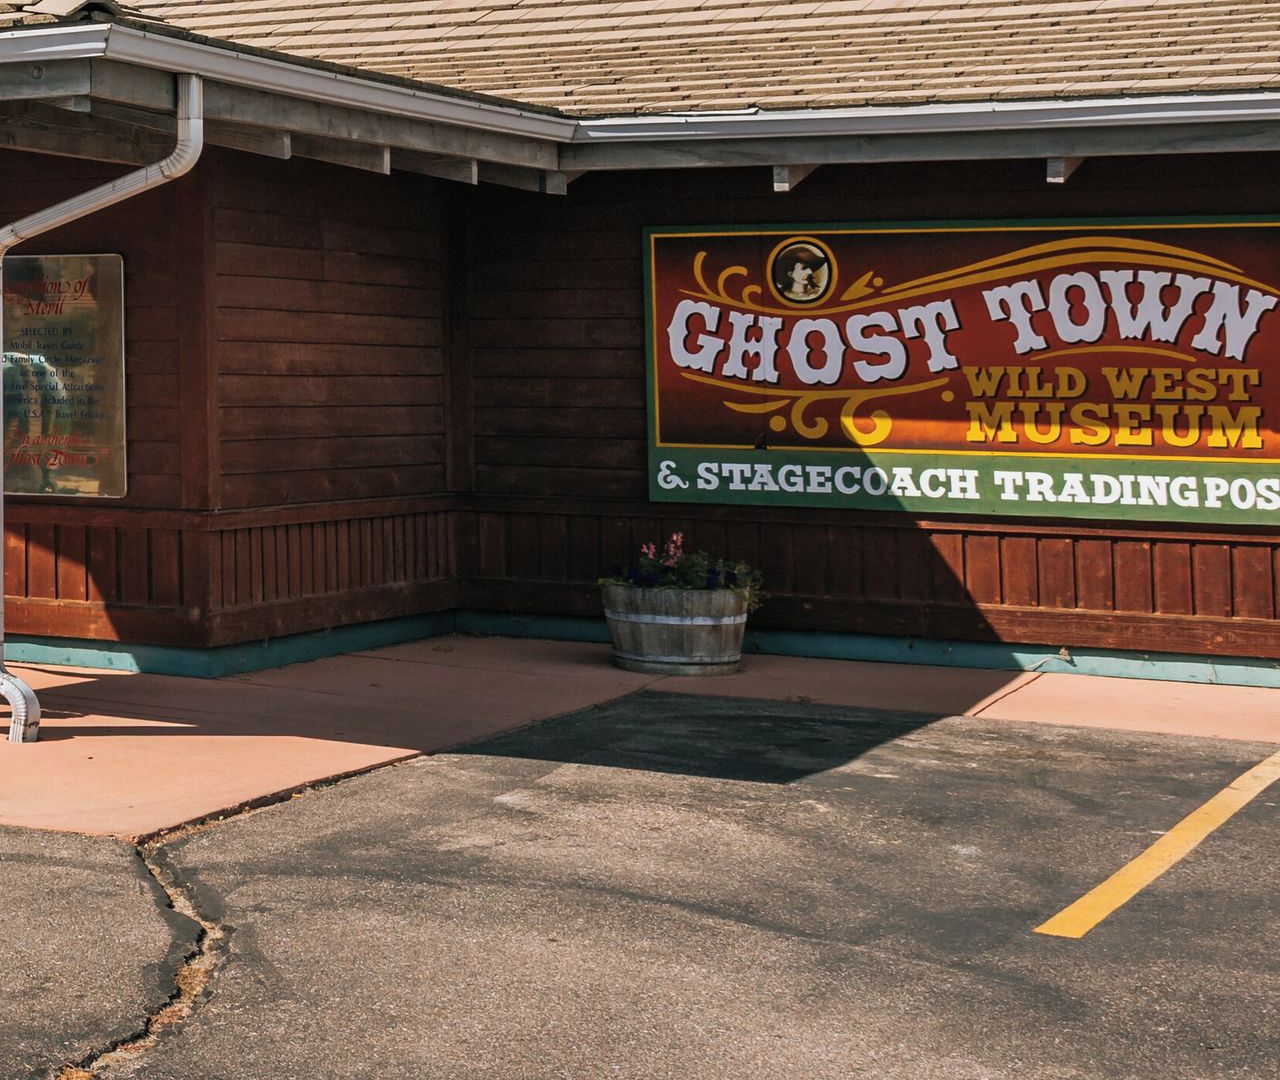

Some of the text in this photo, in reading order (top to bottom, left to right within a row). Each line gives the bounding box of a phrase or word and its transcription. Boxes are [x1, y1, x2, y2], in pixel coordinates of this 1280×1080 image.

[63, 327, 73, 336] BY
[666, 270, 1279, 385] GHOST TOWN
[10, 355, 34, 365] Family
[62, 368, 75, 377] the
[963, 366, 1259, 402] WILD WEST
[30, 382, 58, 392] Special
[965, 401, 1263, 448] MUSEUM
[658, 460, 689, 490] &
[696, 462, 980, 500] STAGECOACH
